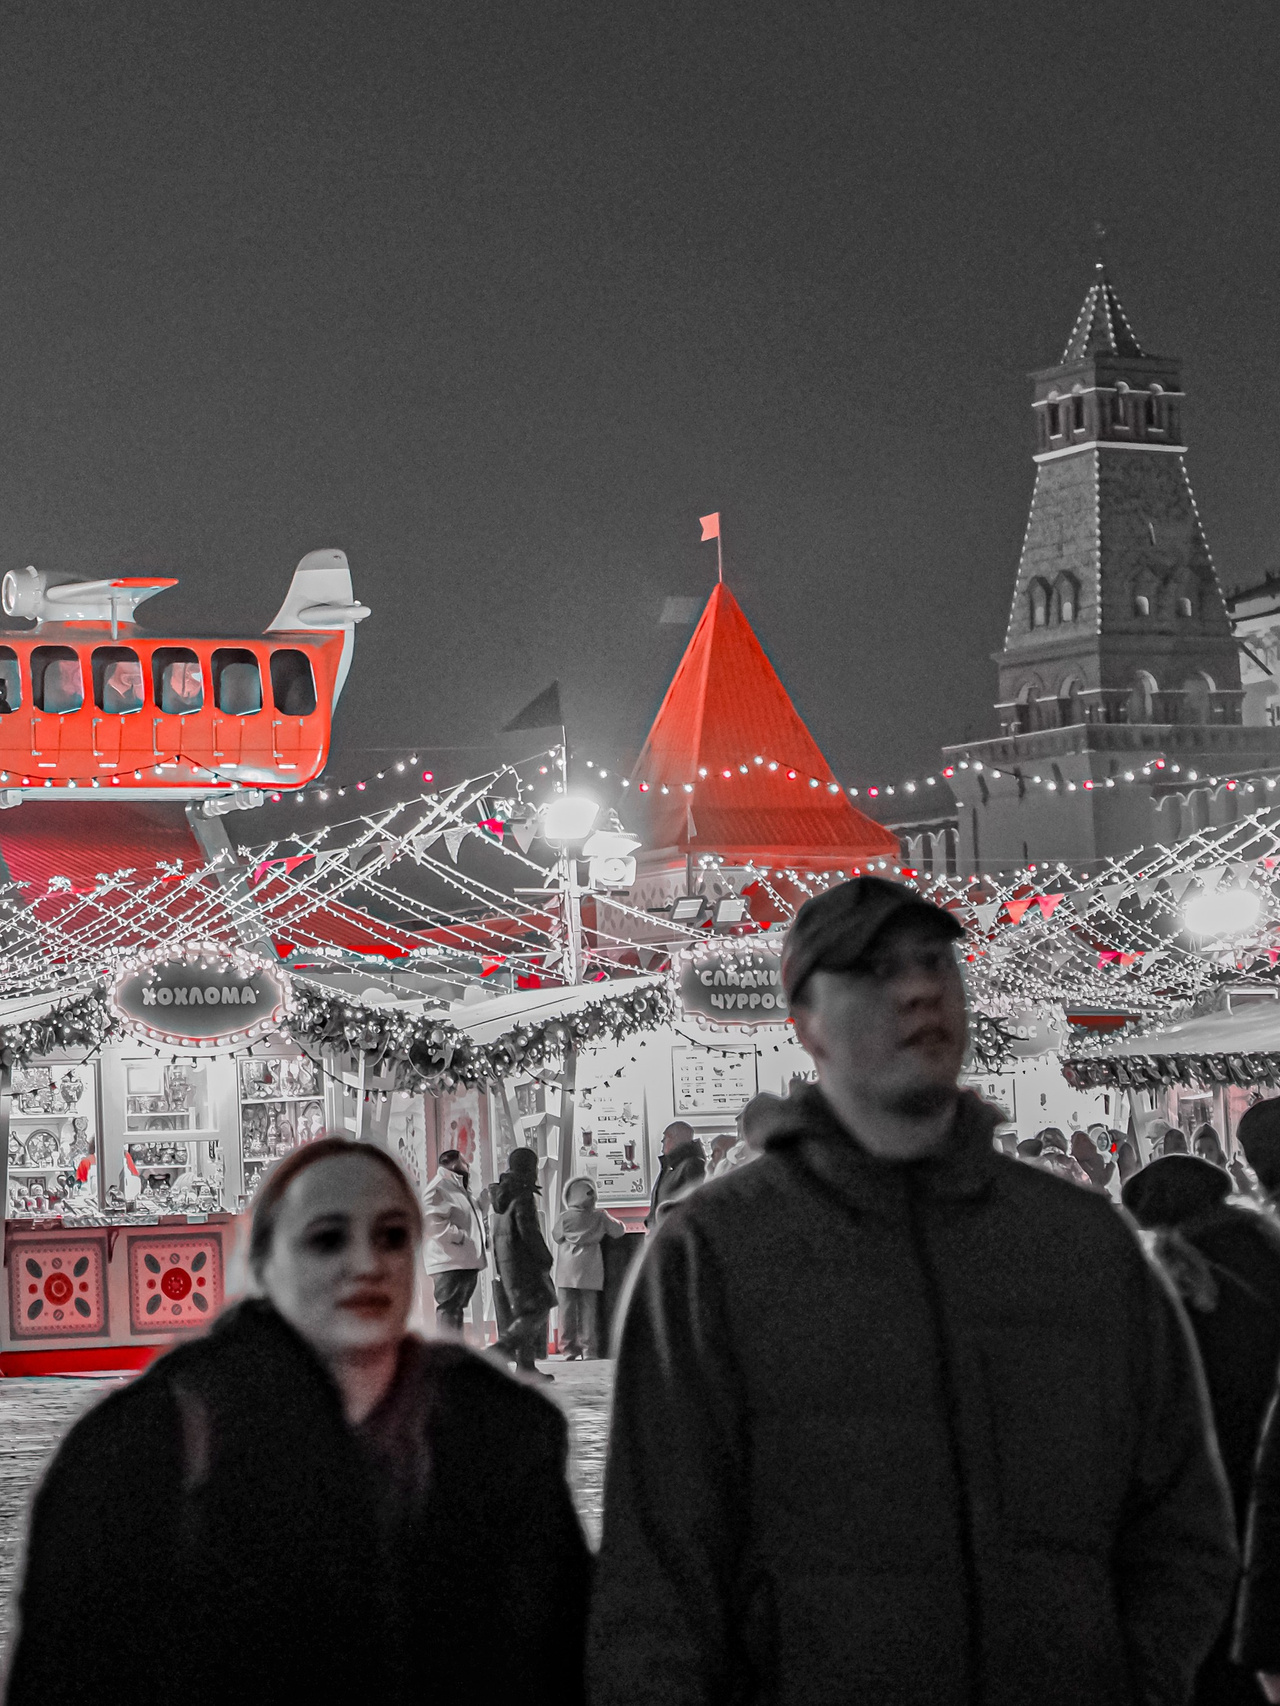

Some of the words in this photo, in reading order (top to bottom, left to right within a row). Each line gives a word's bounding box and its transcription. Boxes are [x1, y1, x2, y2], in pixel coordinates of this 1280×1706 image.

[700, 969, 782, 988] СЛАДКИ
[141, 986, 257, 1006] ХОХЛОМА
[710, 993, 788, 1010] ЧУРРОС
